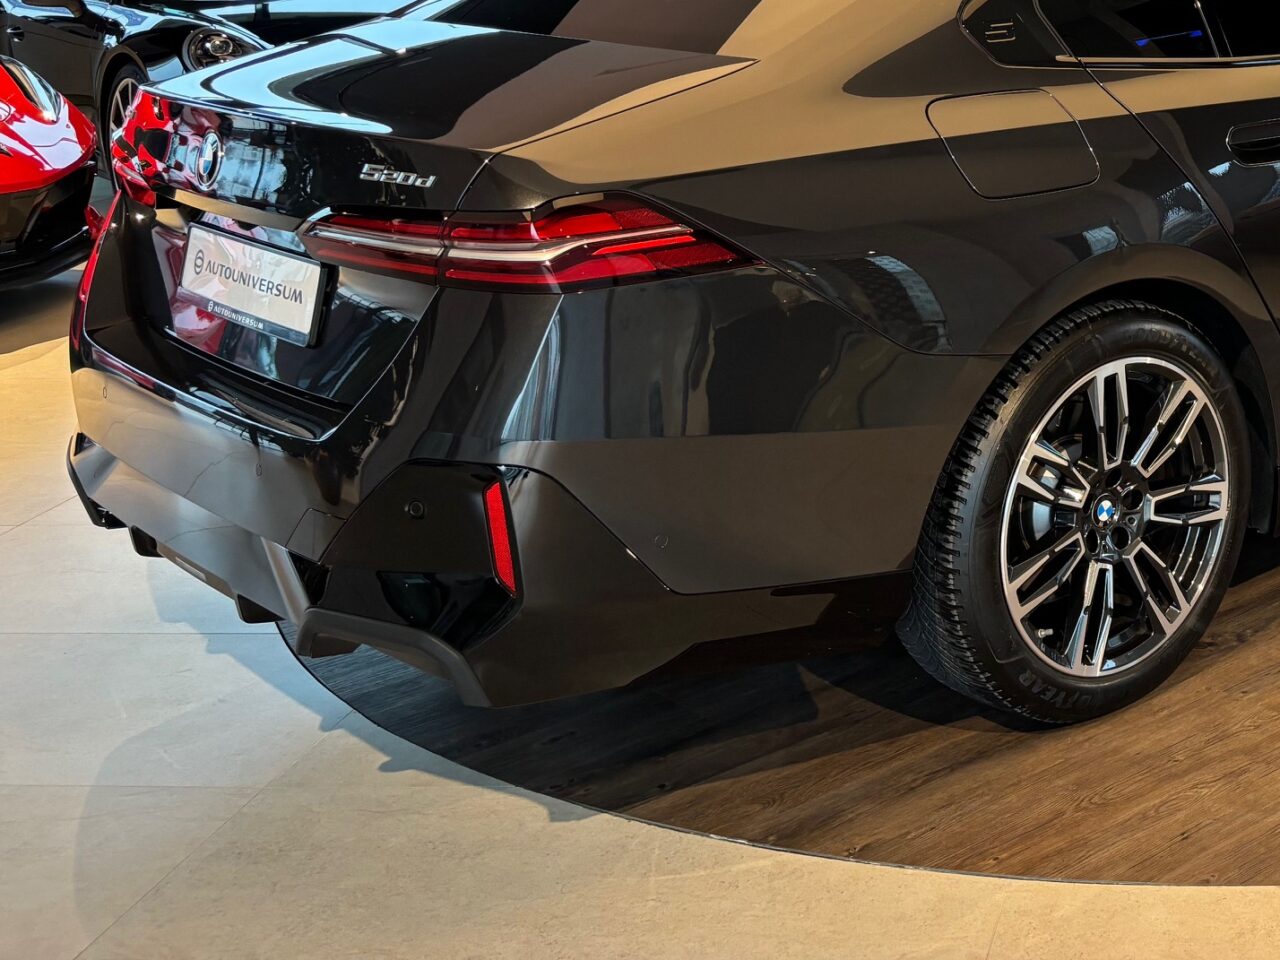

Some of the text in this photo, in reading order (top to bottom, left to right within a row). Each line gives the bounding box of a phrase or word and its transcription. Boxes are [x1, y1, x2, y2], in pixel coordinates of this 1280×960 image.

[359, 163, 437, 188] 520d
[205, 260, 303, 304] AUTOUNIVERSUM
[213, 306, 264, 330] AUTOUNIVERSUM
